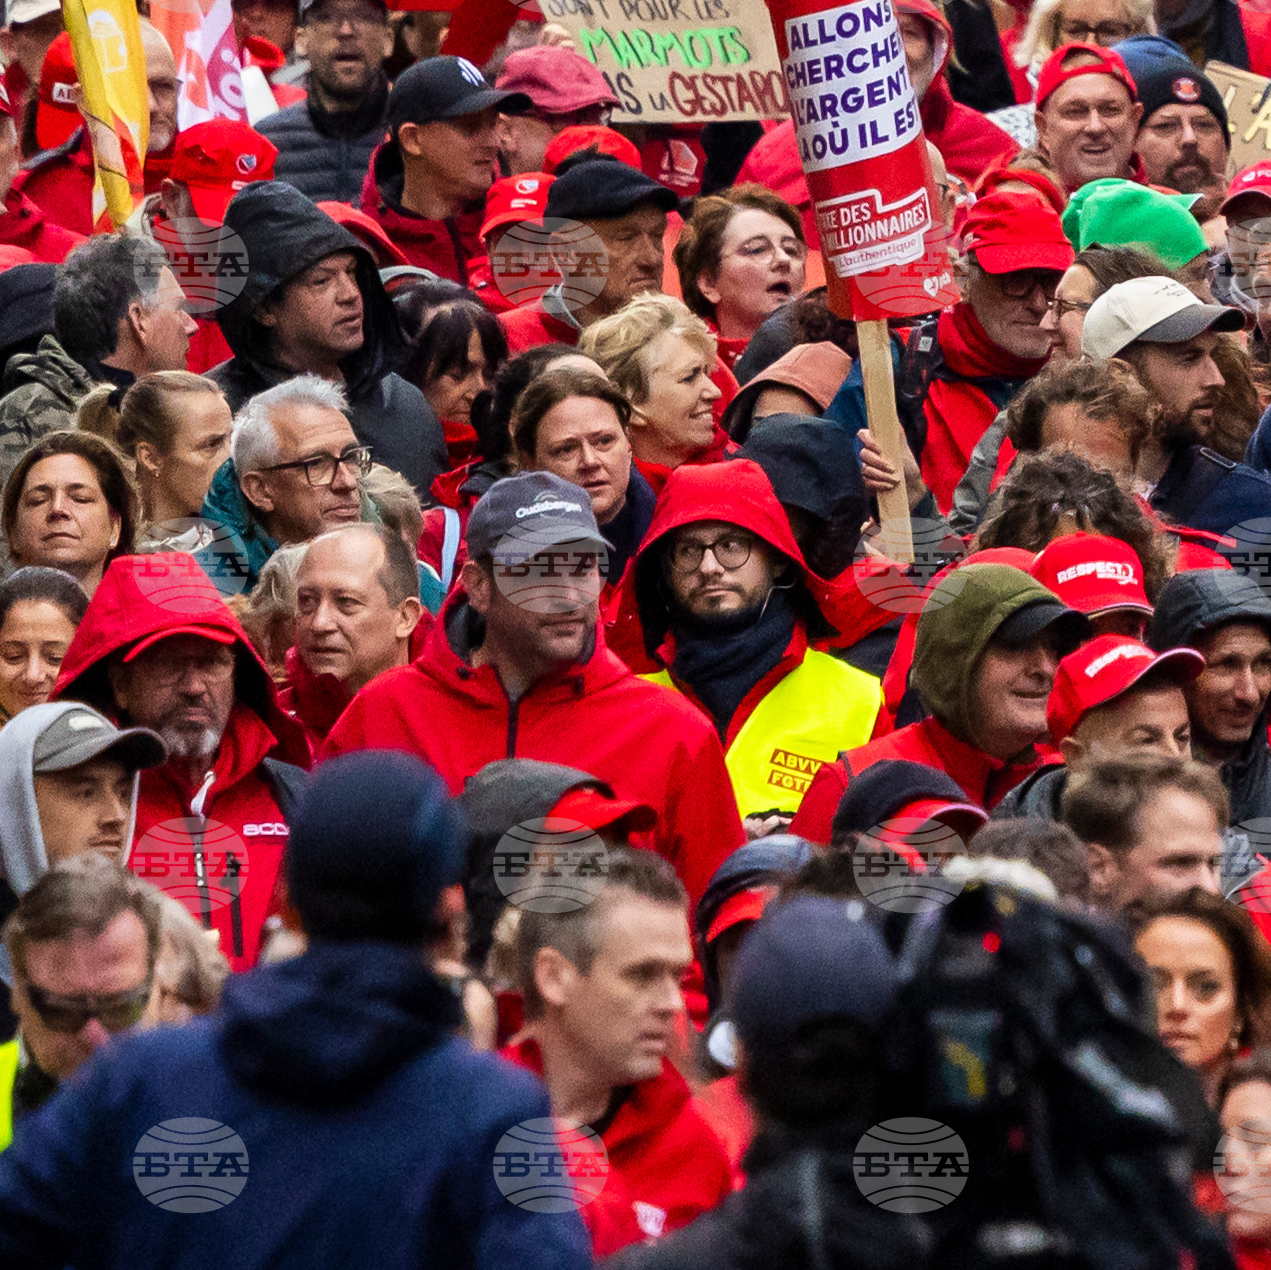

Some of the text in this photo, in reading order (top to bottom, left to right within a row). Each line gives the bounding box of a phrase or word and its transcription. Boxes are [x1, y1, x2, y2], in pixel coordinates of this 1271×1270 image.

[579, 26, 752, 69] MARMOTS
[785, 30, 904, 90] CHERCHE
[667, 70, 790, 117] GESTAPO
[811, 119, 850, 160] OÙ
[858, 119, 890, 149] IL
[840, 202, 871, 227] DES
[773, 751, 822, 775] ABVV
